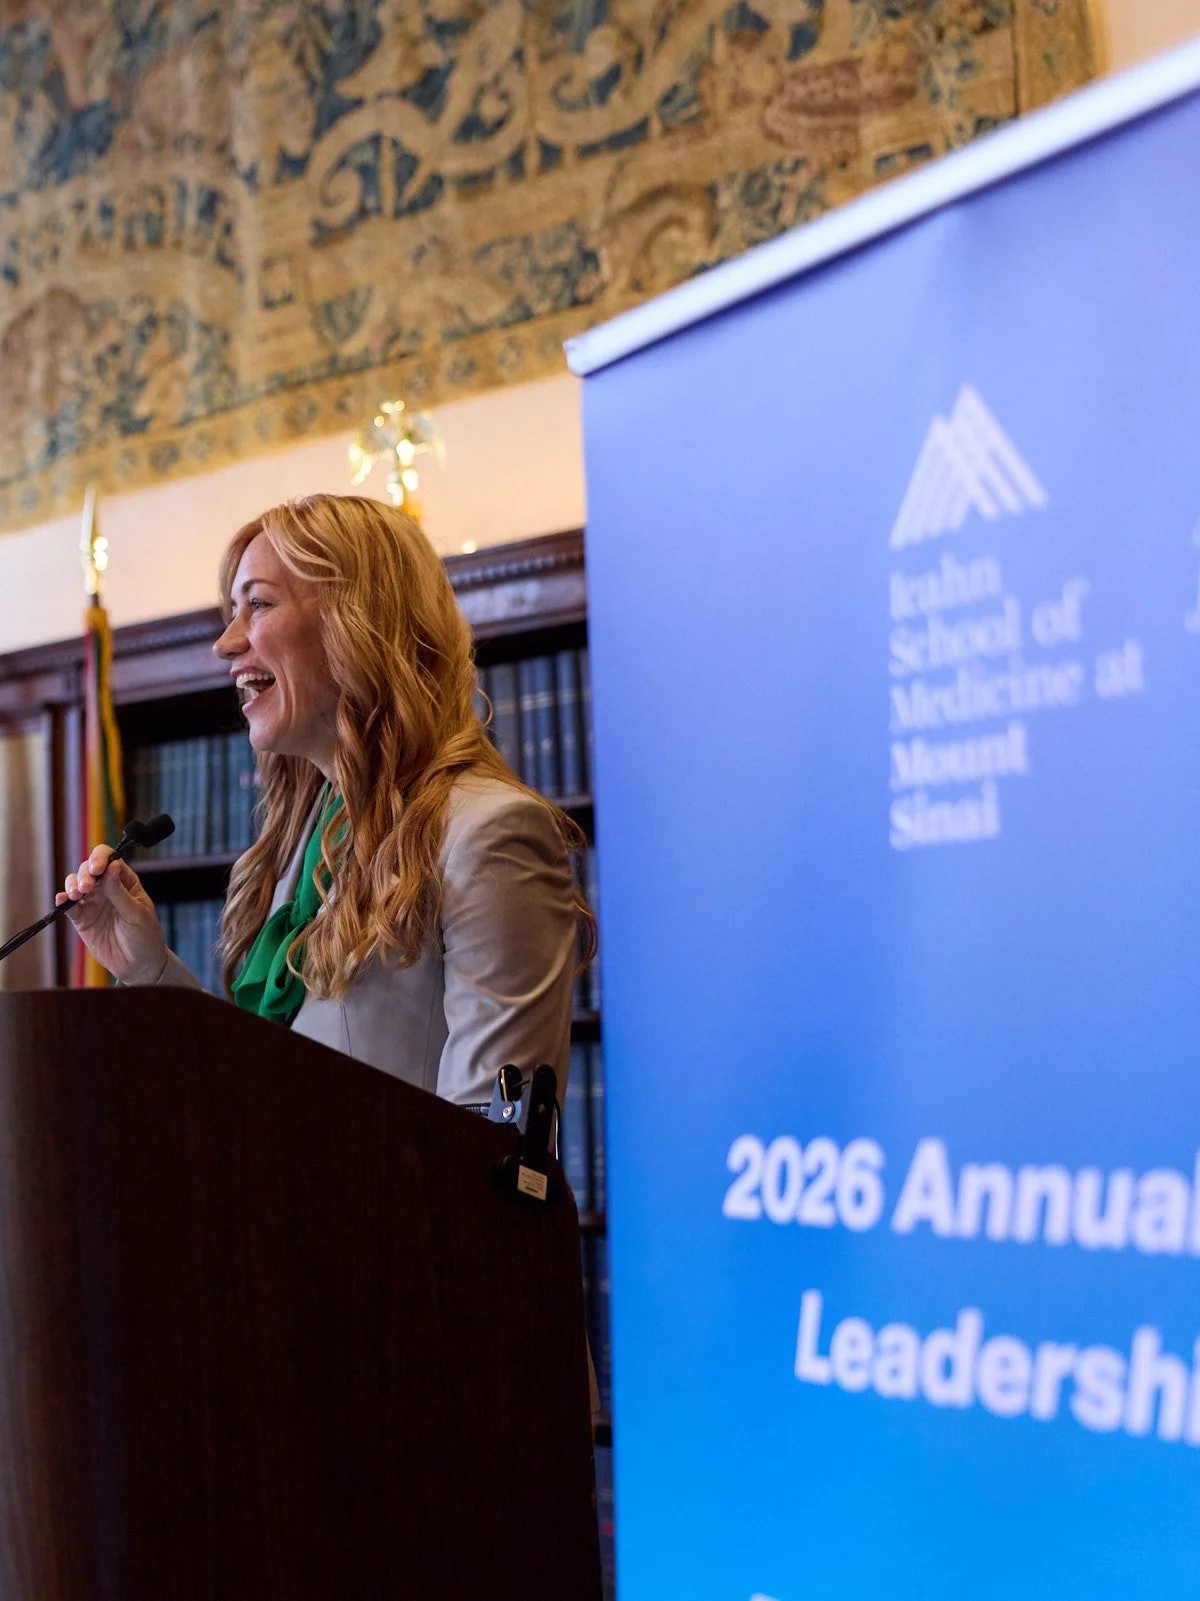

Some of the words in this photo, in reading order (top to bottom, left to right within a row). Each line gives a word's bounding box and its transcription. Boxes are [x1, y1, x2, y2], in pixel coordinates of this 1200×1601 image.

[890, 597, 1021, 676] School
[1032, 577, 1090, 646] of
[890, 656, 1084, 732] Medicine
[891, 722, 1028, 789] Mount
[890, 779, 1000, 849] Sinai
[722, 1134, 886, 1231] 2026
